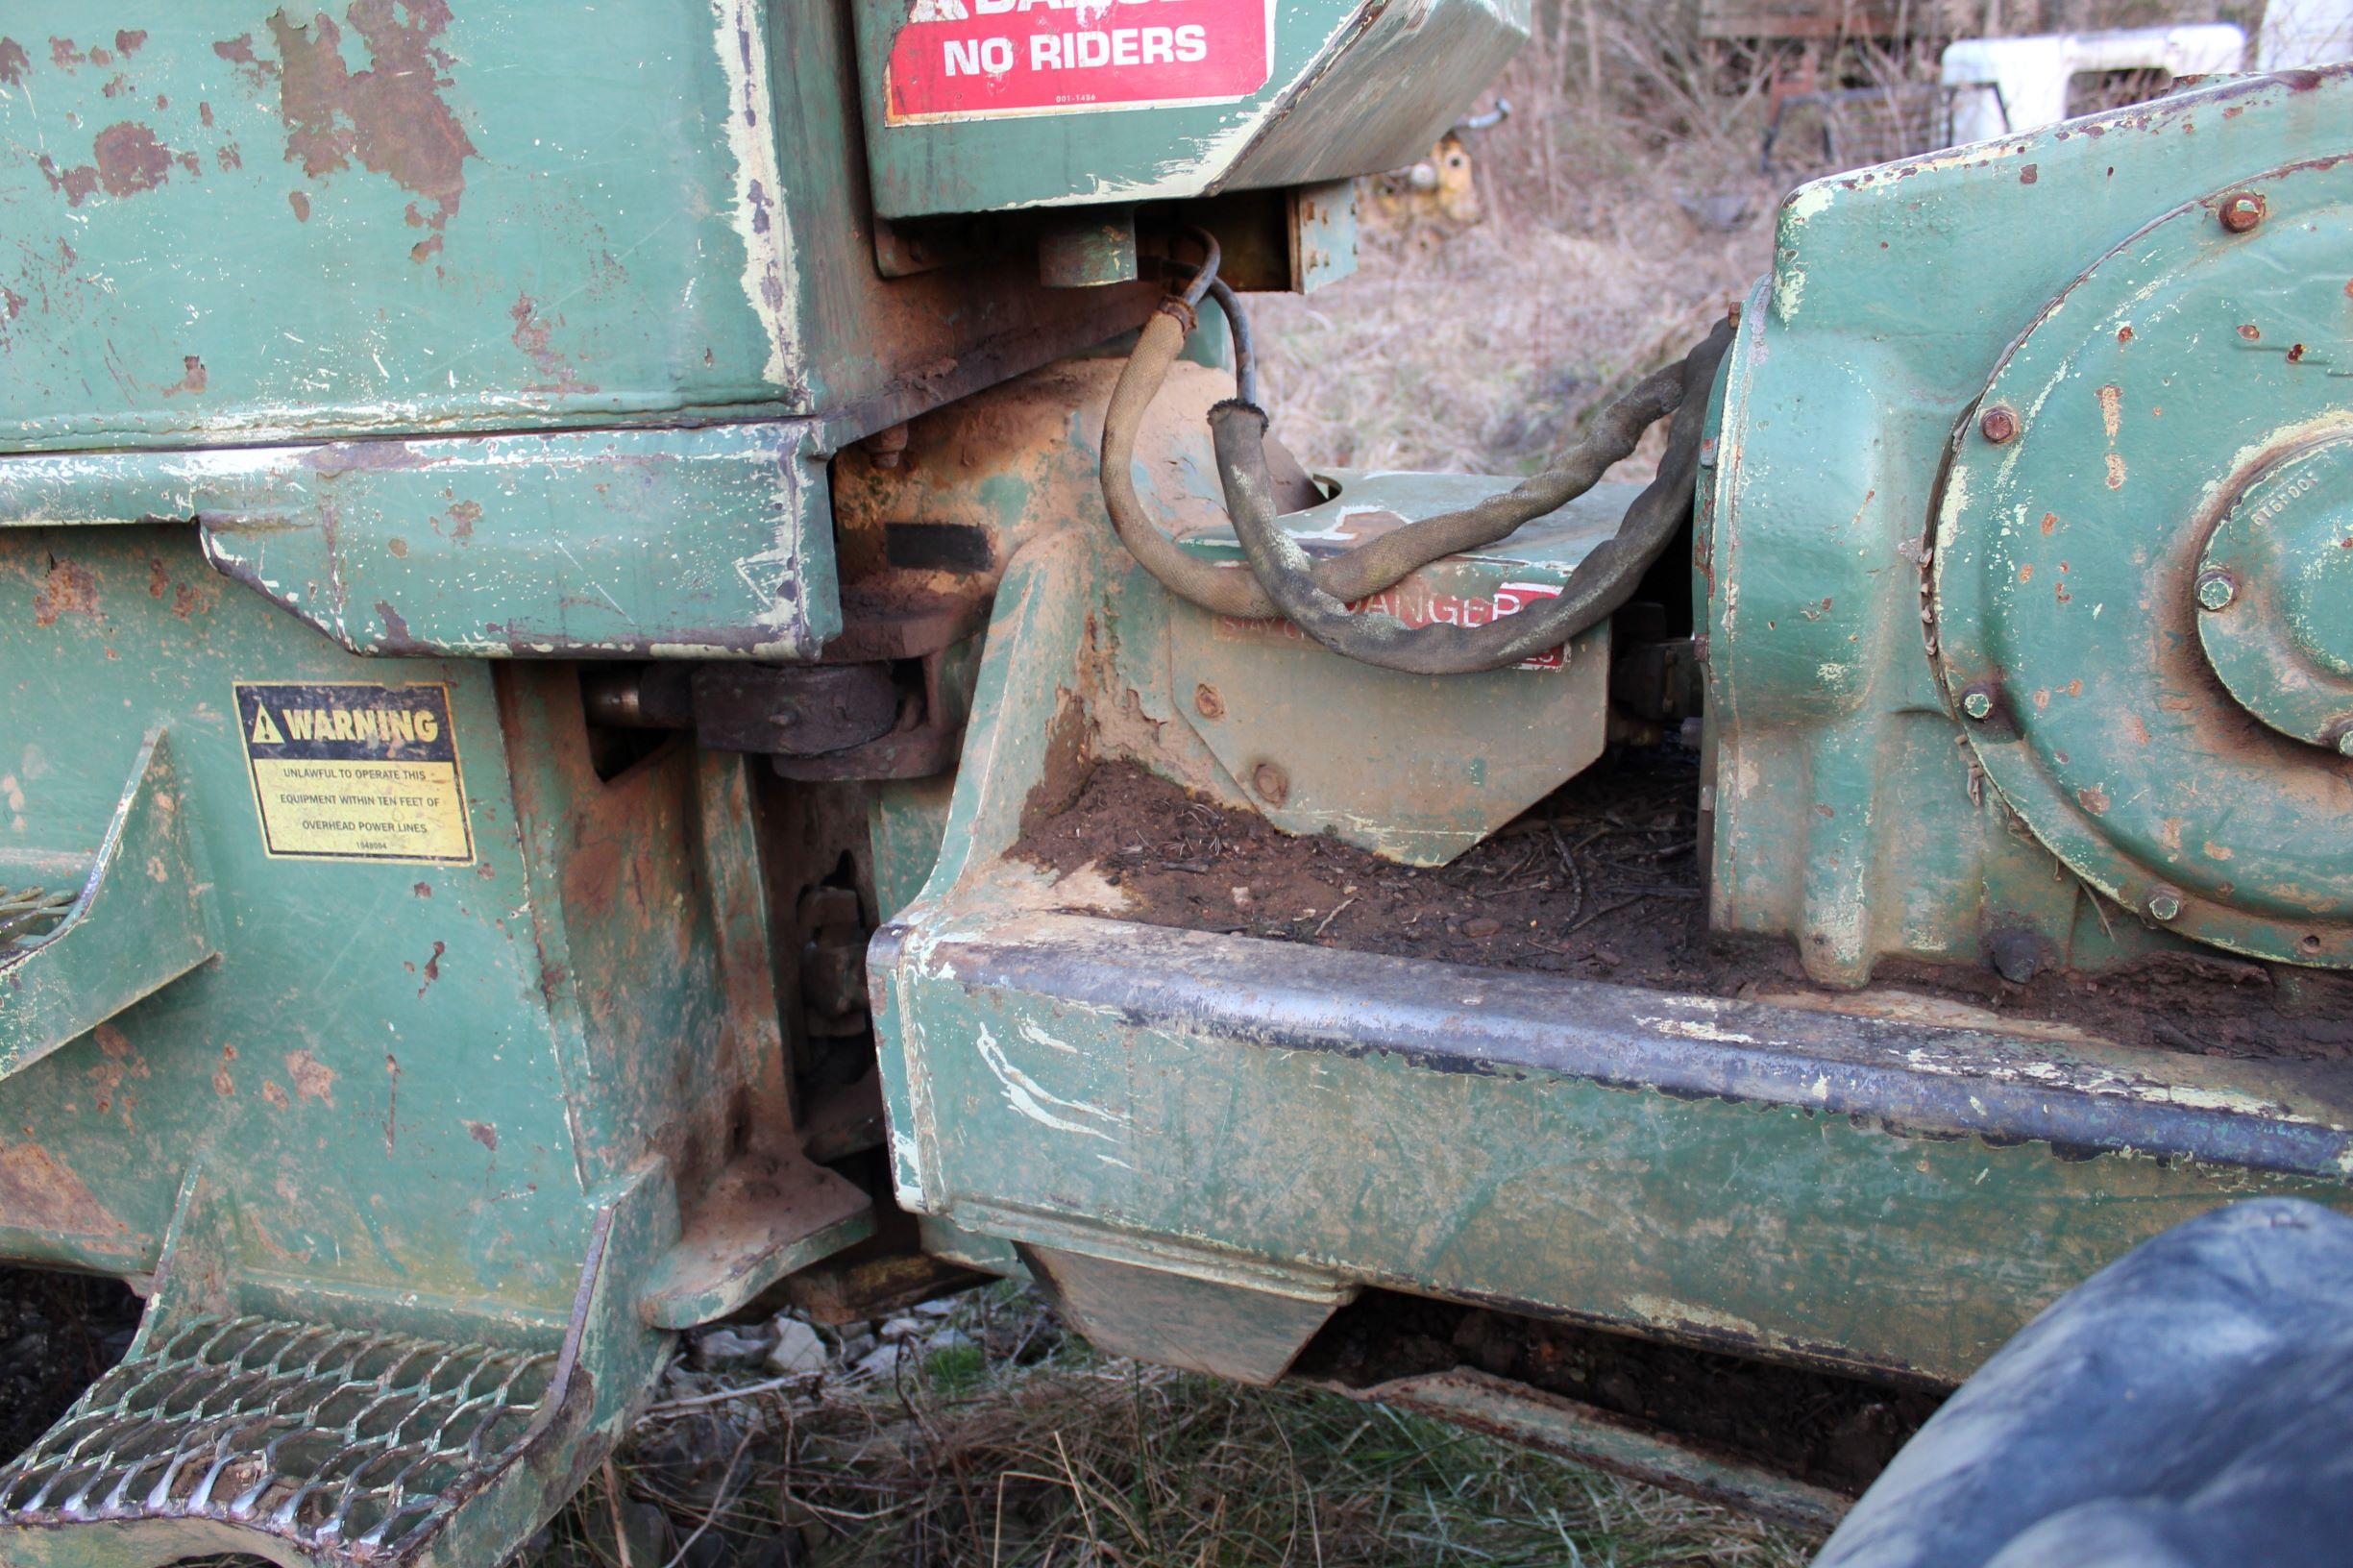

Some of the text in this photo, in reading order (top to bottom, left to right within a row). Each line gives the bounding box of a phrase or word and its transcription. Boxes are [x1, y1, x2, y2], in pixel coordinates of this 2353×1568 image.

[943, 24, 1207, 77] NO RIDERS
[282, 708, 438, 743] WARNING
[283, 768, 426, 780] UNLAWFUL TO OPERATE THIS
[281, 794, 440, 807] EQUIPMENT WITHIN TEN FEET OF
[302, 820, 428, 833] OVERHEAD POWER LINES
